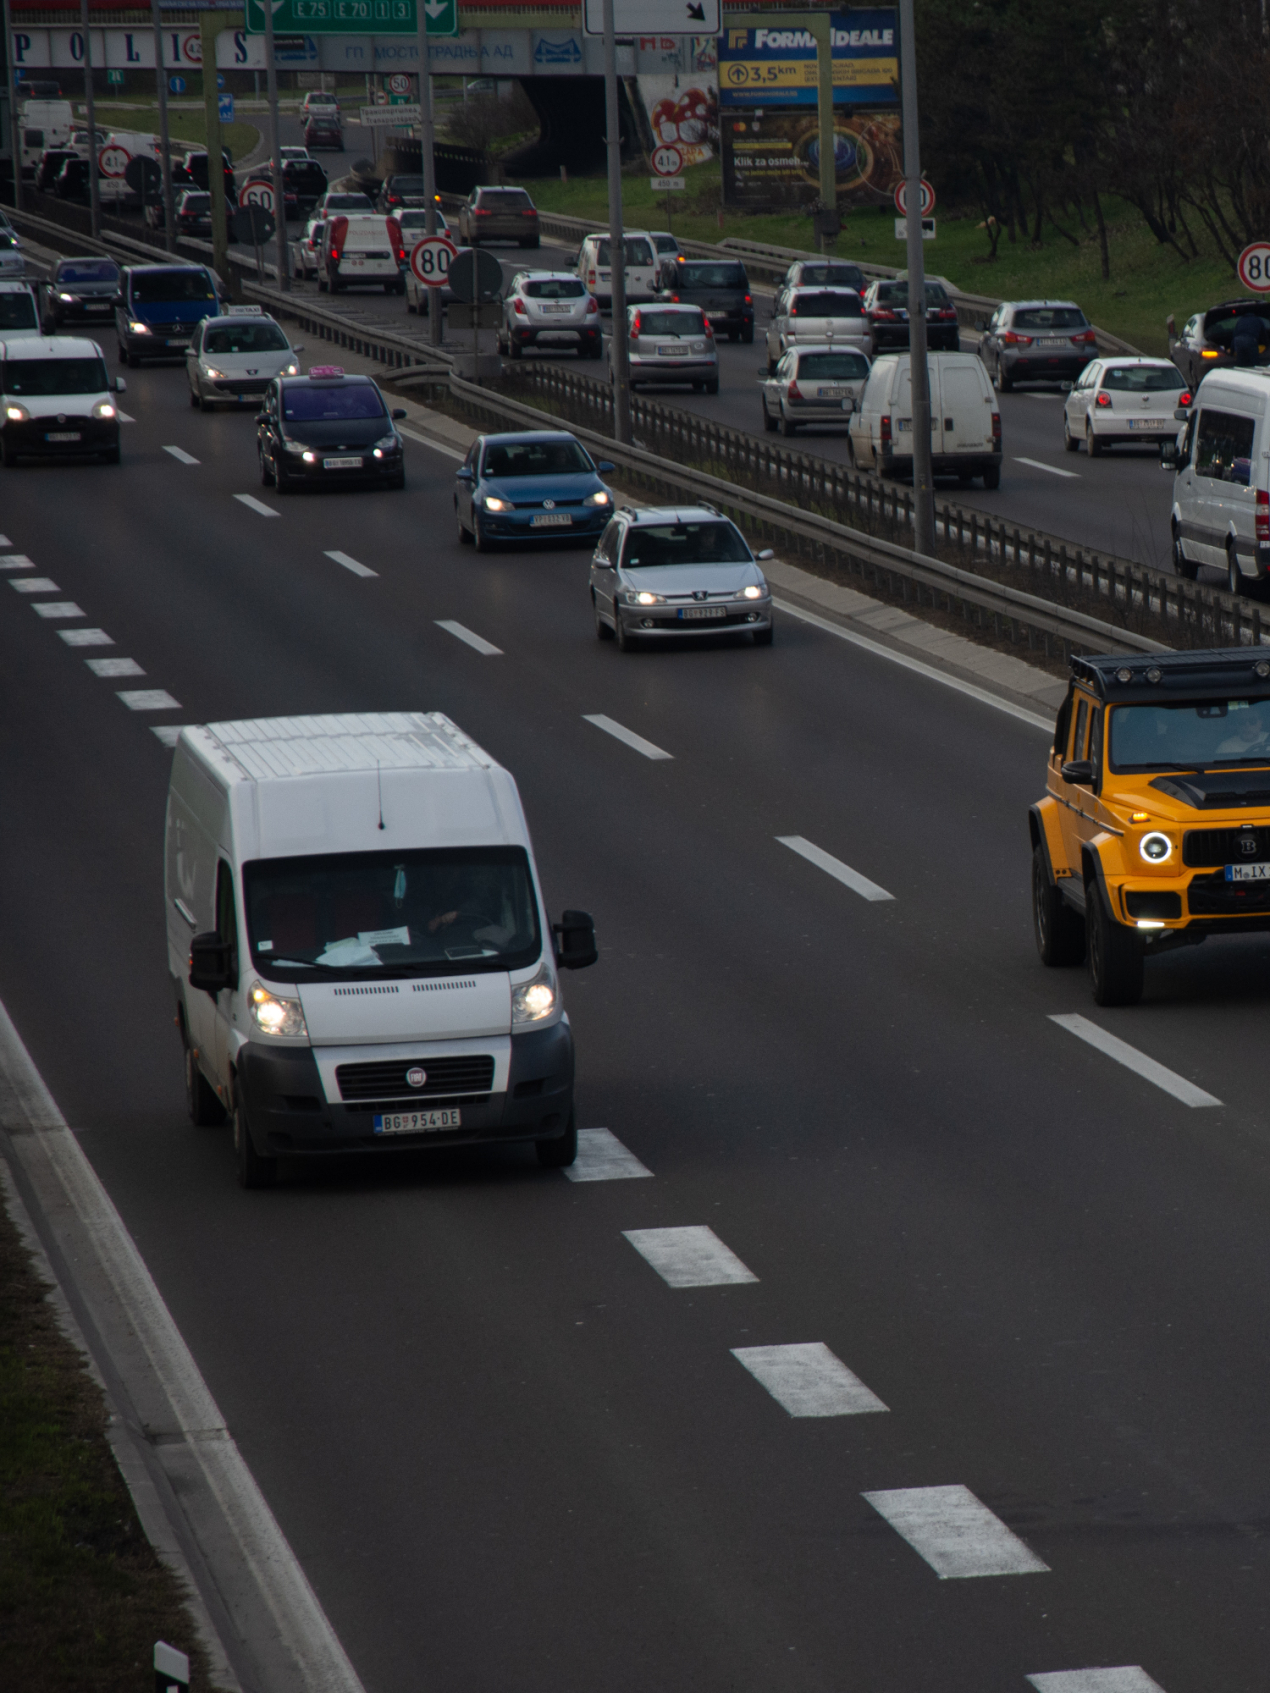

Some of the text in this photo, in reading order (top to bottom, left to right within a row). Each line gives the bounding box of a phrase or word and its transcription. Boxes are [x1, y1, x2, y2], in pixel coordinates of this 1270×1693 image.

[297, 2, 326, 16] E 75
[339, 2, 367, 16] E 70
[398, 2, 406, 17] 3
[393, 77, 407, 90] 50
[104, 156, 119, 168] 4.1
[657, 154, 670, 167] 4.1
[733, 156, 754, 167] Klik
[754, 157, 767, 167] za
[247, 190, 272, 215] 60
[421, 248, 450, 274] 80
[1234, 866, 1243, 879] M
[384, 1116, 401, 1130] BG
